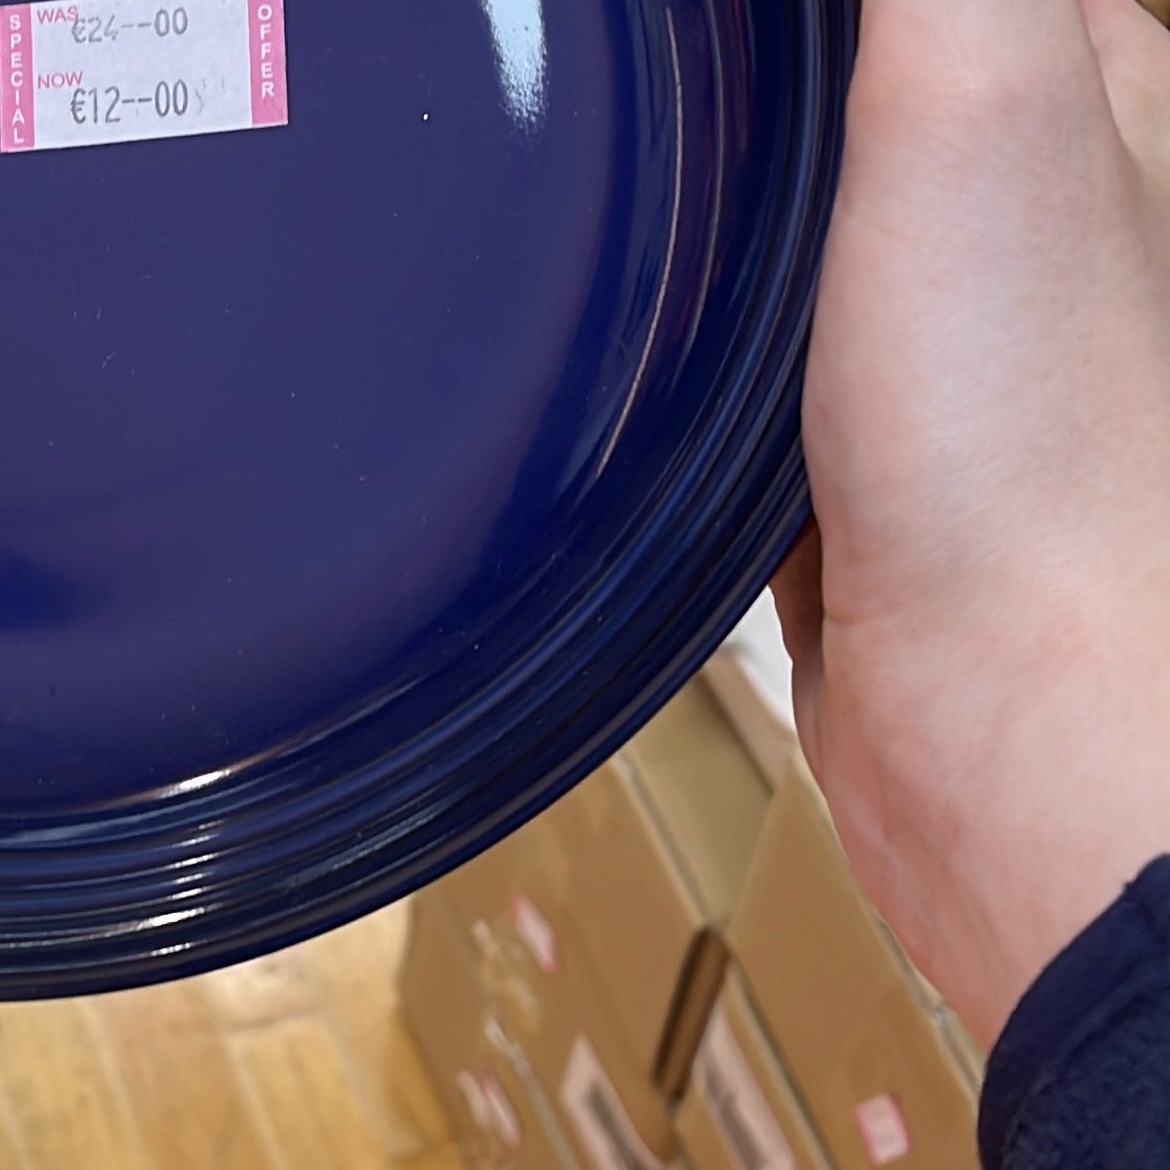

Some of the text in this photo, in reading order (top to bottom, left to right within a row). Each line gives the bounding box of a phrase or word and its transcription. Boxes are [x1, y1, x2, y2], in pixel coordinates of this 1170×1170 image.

[37, 6, 78, 24] WAS
[258, 4, 274, 97] OFFER
[9, 14, 25, 144] SPECIAL
[37, 71, 83, 90] NOW
